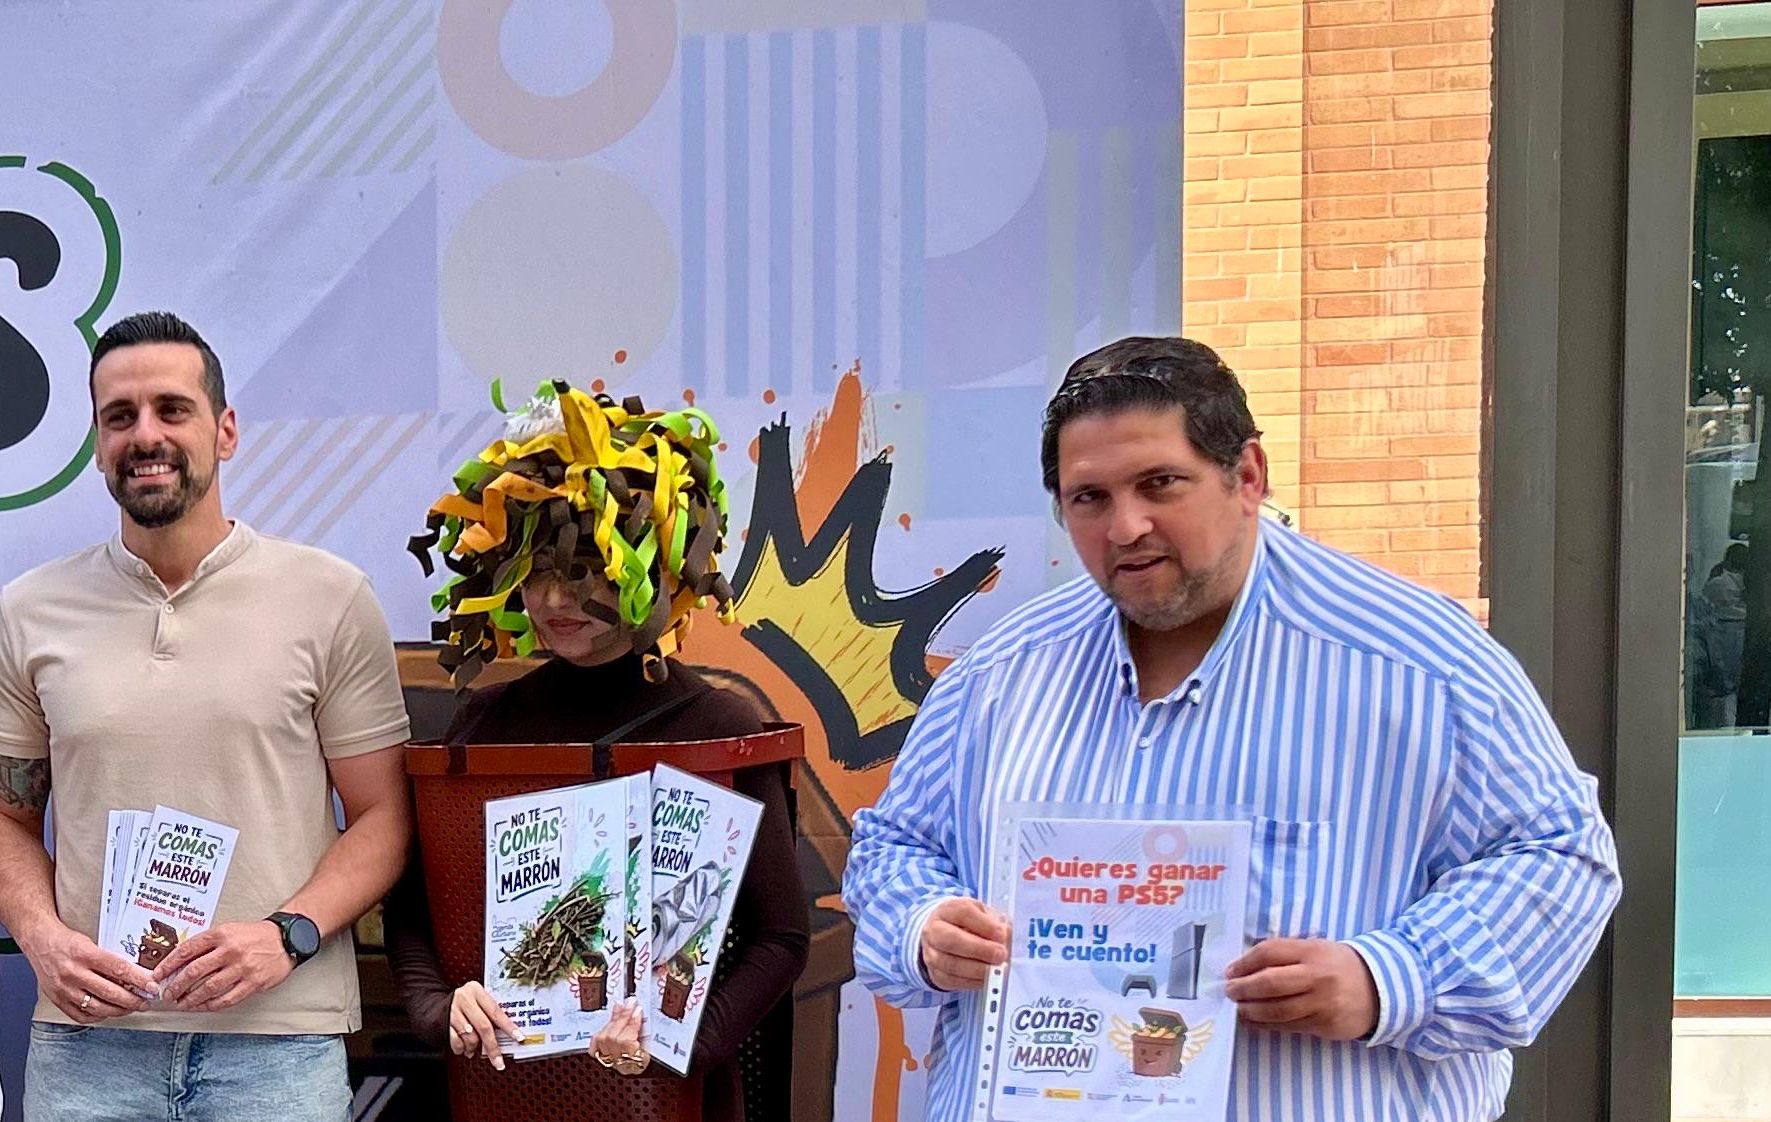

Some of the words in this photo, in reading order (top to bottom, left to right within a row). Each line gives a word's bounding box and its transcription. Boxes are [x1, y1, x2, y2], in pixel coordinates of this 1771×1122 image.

[668, 787, 681, 802] NO
[683, 790, 694, 805] TE
[511, 812, 525, 828] NO
[528, 807, 541, 822] TE
[652, 801, 704, 833] COMAS
[174, 823, 188, 834] NO
[191, 827, 203, 838] TE
[499, 817, 559, 857] COMAS
[661, 830, 682, 845] ESTE
[158, 832, 217, 860] COMAS
[518, 848, 540, 866] ESTE
[171, 853, 194, 866] ESTE
[1023, 856, 1138, 880] ¿Quieres
[1147, 863, 1227, 884] ganar
[149, 860, 211, 887] MARRÓN
[501, 855, 560, 896] MARRÓN
[1060, 886, 1108, 904] una
[1117, 884, 1184, 905] PS5?
[1028, 918, 1083, 939] ¡Ven
[1093, 924, 1108, 945] y
[1028, 940, 1052, 959] te
[1061, 943, 1157, 963] cuento!
[1035, 996, 1054, 1008] No
[1058, 997, 1075, 1008] te
[1013, 1043, 1093, 1068] MARRÓN
